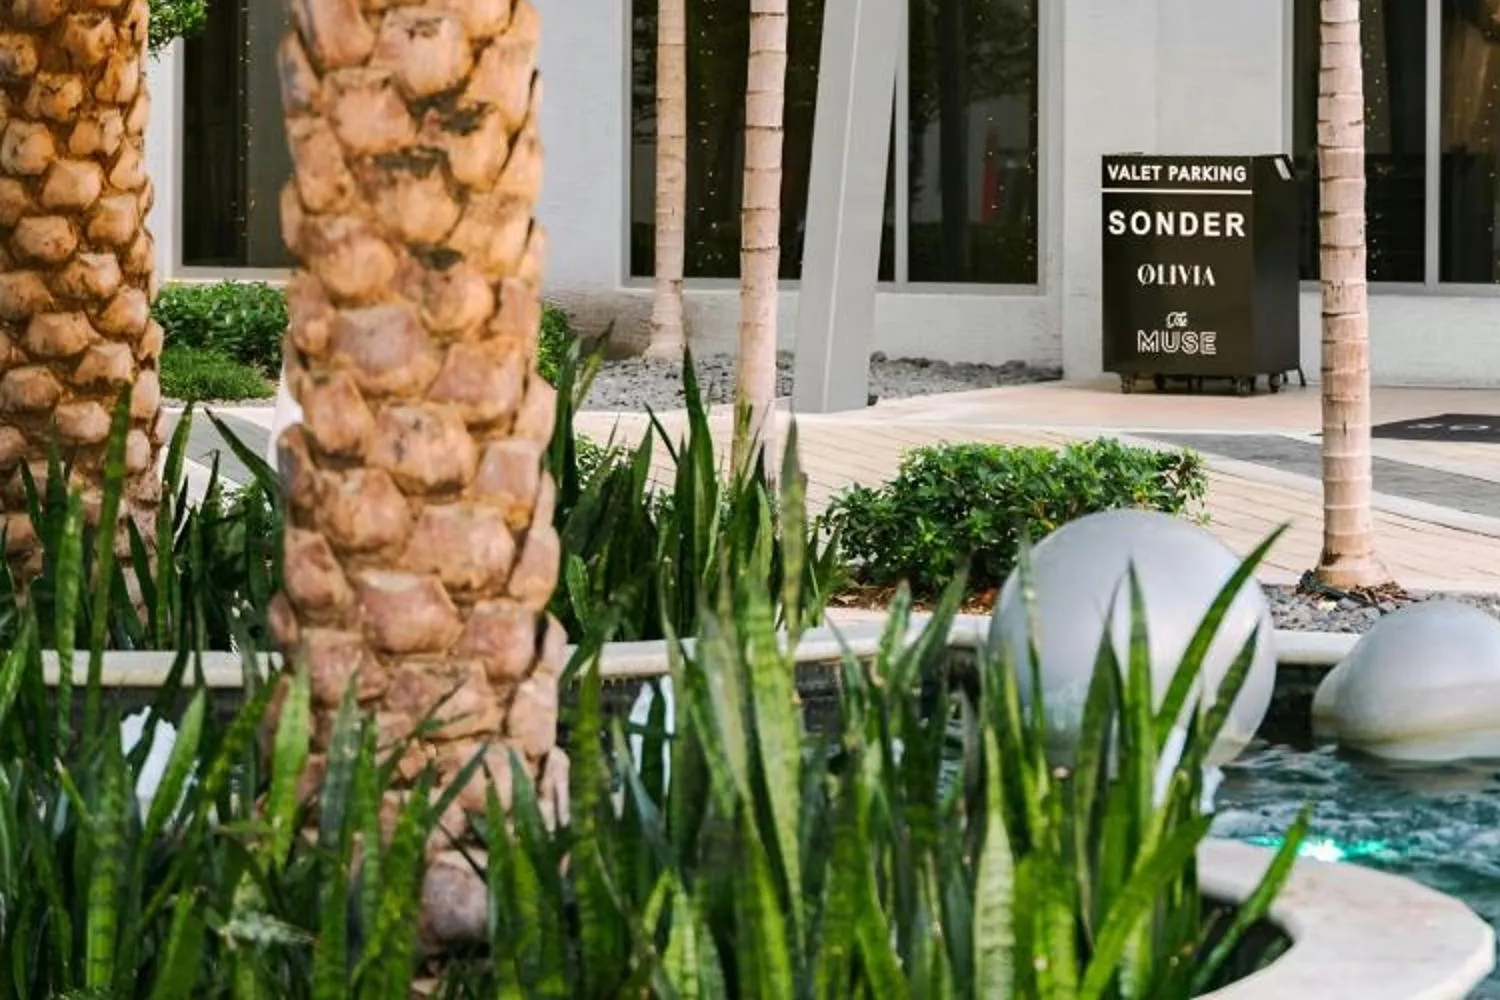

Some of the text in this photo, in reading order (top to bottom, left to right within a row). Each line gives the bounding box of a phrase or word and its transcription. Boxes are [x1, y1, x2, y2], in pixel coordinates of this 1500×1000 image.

[1107, 165, 1247, 183] VALET PARKING
[1108, 210, 1246, 237] SONDER
[1137, 330, 1217, 355] MUSE
